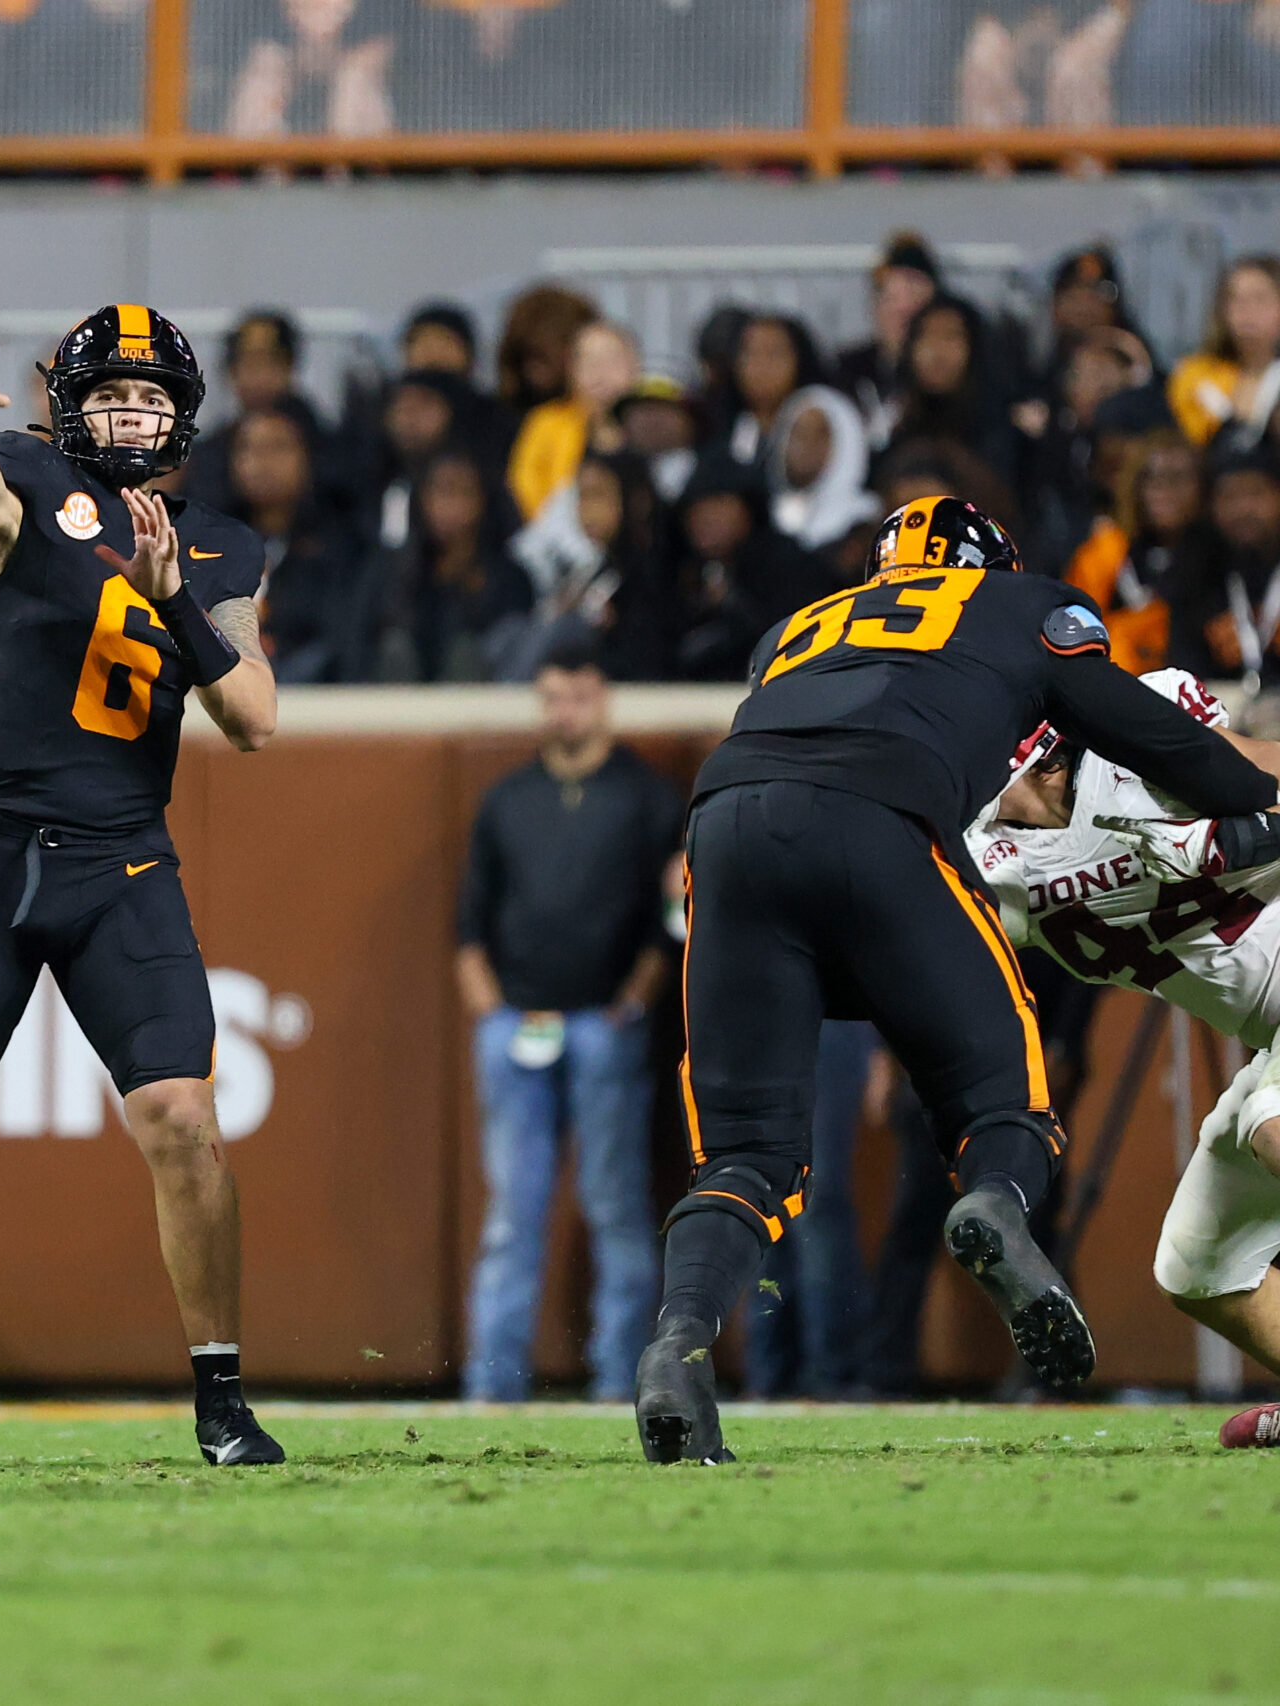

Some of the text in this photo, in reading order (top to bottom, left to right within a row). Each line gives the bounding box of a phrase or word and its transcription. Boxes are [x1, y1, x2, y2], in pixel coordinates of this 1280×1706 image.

[120, 348, 155, 360] VOLS
[67, 494, 96, 527] SEC
[925, 535, 949, 567] 3
[72, 573, 168, 741] 6
[761, 568, 987, 687] 53
[1039, 873, 1267, 993] 44
